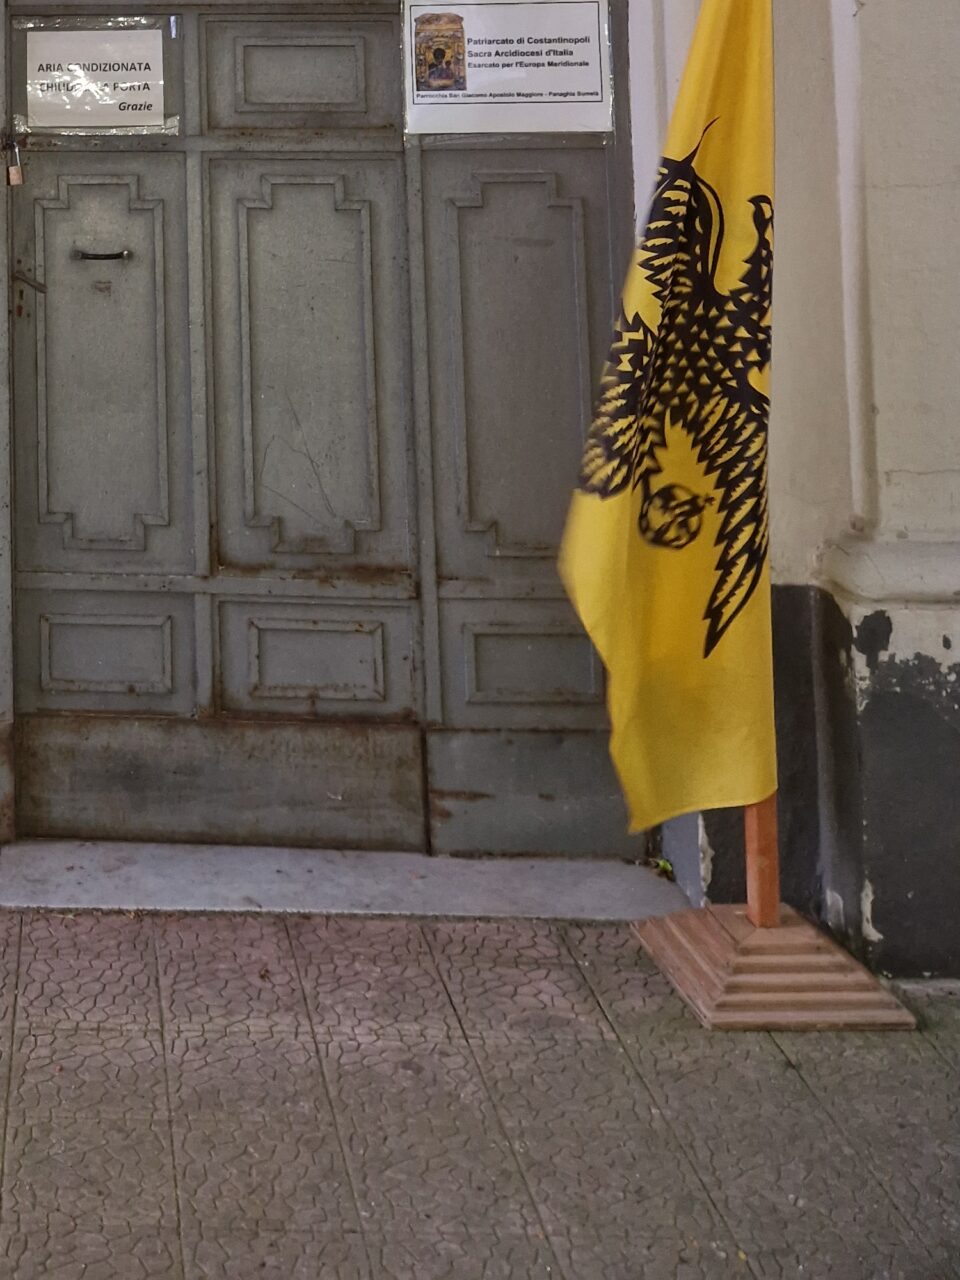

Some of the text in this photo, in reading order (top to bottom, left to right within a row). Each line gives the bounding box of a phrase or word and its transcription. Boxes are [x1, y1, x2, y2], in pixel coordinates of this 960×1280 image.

[466, 35, 591, 45] Patriarcato di Costantinopoli
[467, 48, 574, 58] Sacra Arcidiocesi d'Italia
[37, 62, 64, 73] ARIA
[467, 60, 590, 70] Esarcato per l'Europa Meridionale
[118, 101, 153, 111] Grazie
